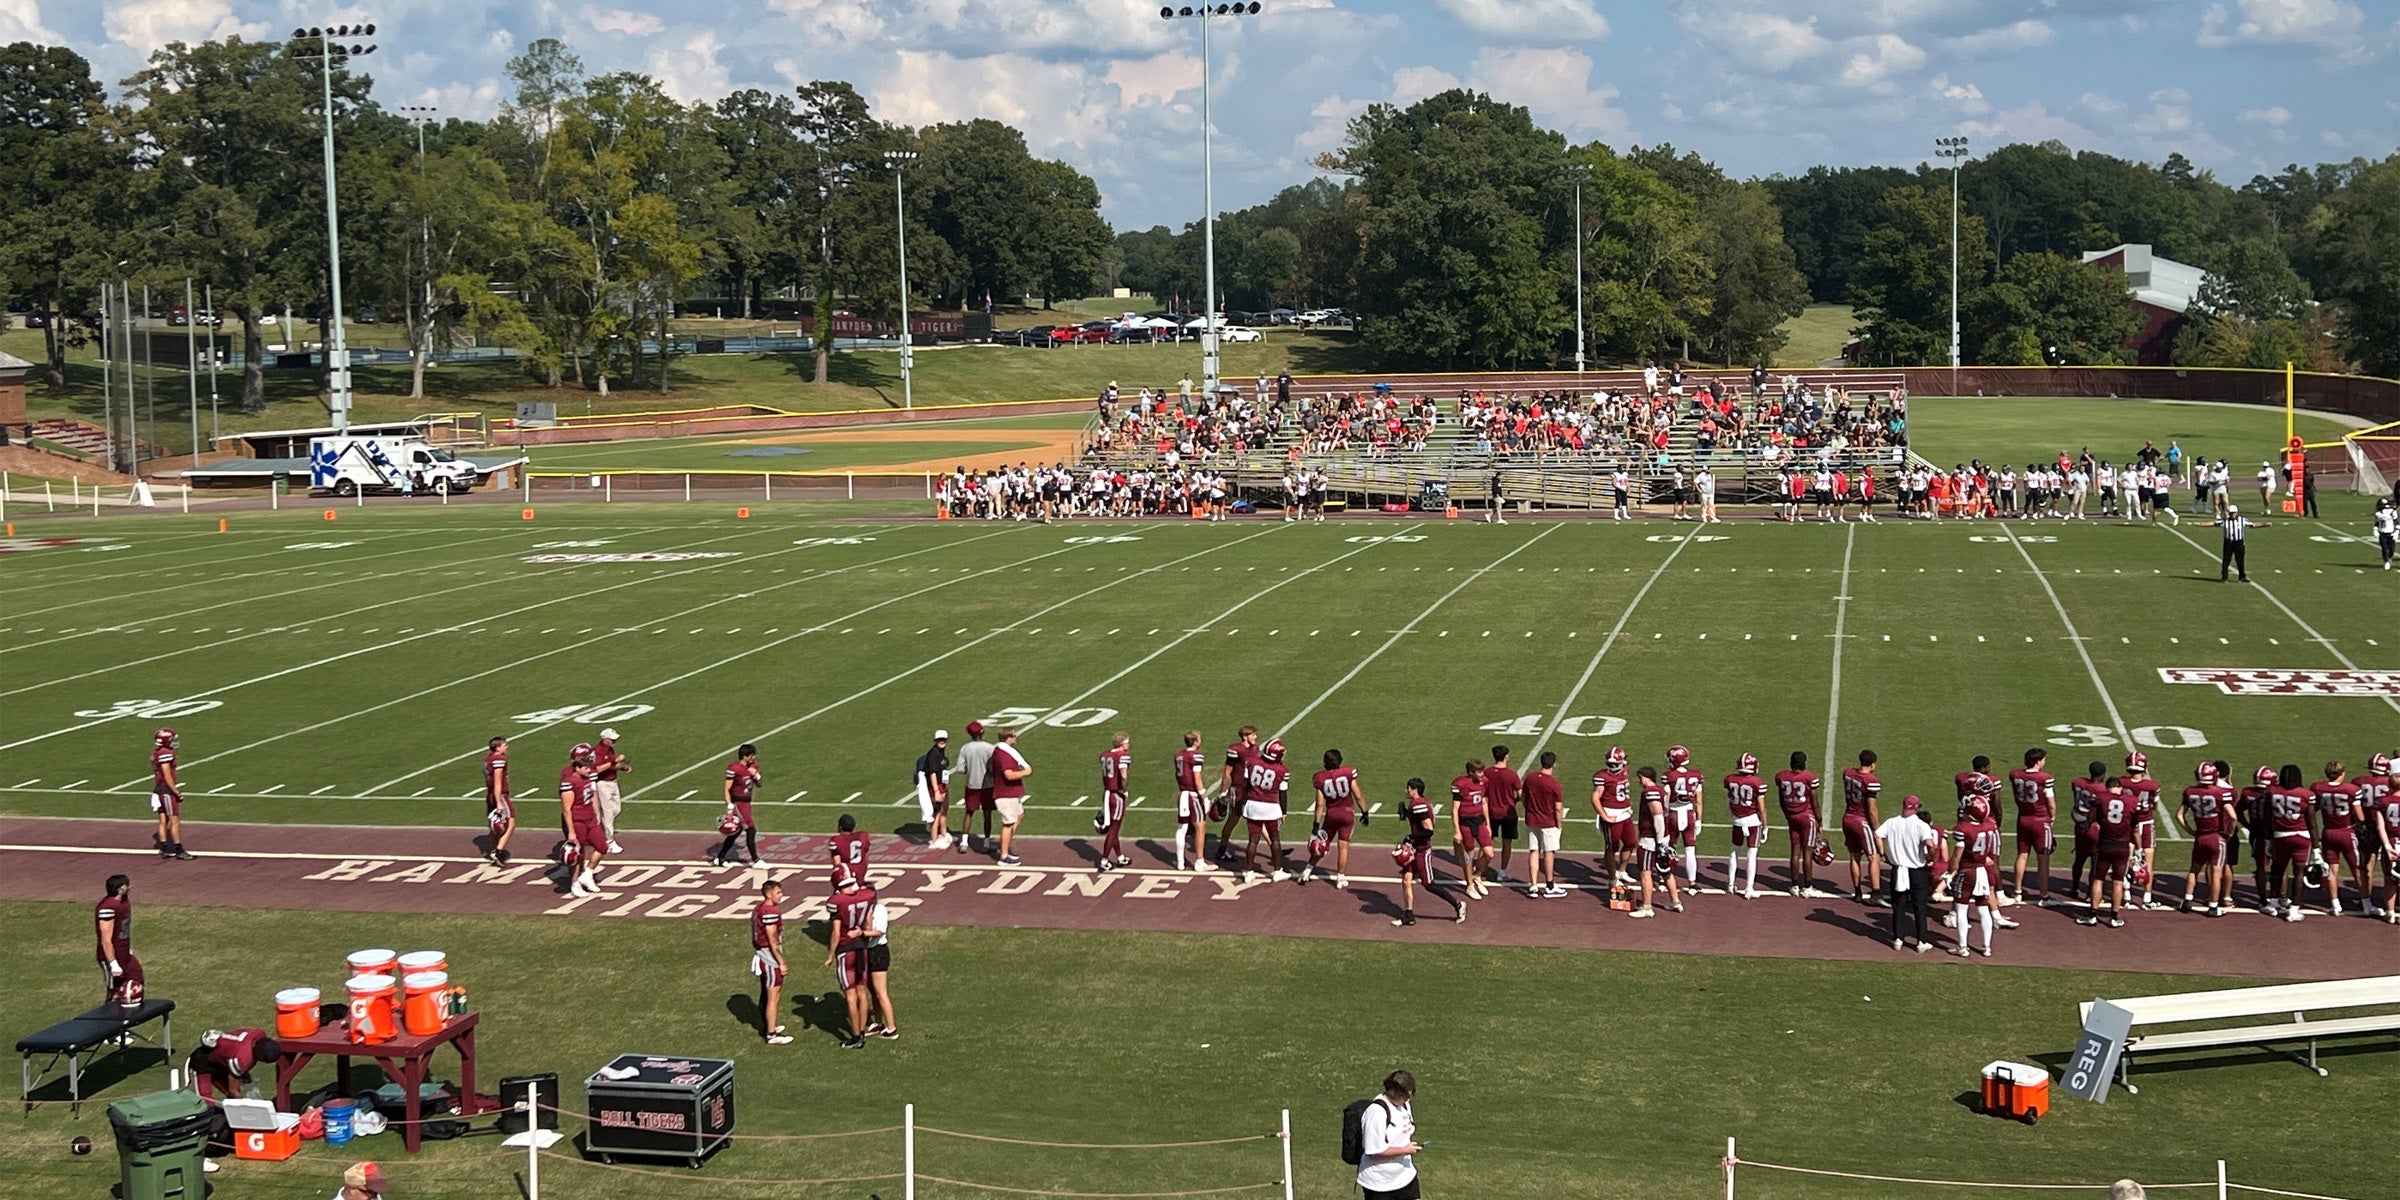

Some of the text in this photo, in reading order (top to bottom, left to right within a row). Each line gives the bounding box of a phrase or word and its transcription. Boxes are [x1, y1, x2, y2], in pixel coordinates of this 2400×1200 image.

[74, 699, 223, 718] 30
[510, 703, 655, 724] 40
[977, 706, 1119, 728] 50
[1480, 714, 1627, 737] 40
[2046, 724, 2209, 749] 30
[1250, 764, 1276, 791] 68
[1323, 776, 1350, 799] 40
[2107, 799, 2125, 824] 8
[849, 840, 863, 865] 6
[302, 859, 1273, 901] HAMDEN-SYDNEY
[543, 892, 924, 921] TIGERS
[847, 900, 869, 929] 17
[351, 999, 367, 1019] G
[2071, 1039, 2102, 1090] REG
[600, 1110, 686, 1130] ROLL TIGERS
[248, 1132, 265, 1151] G
